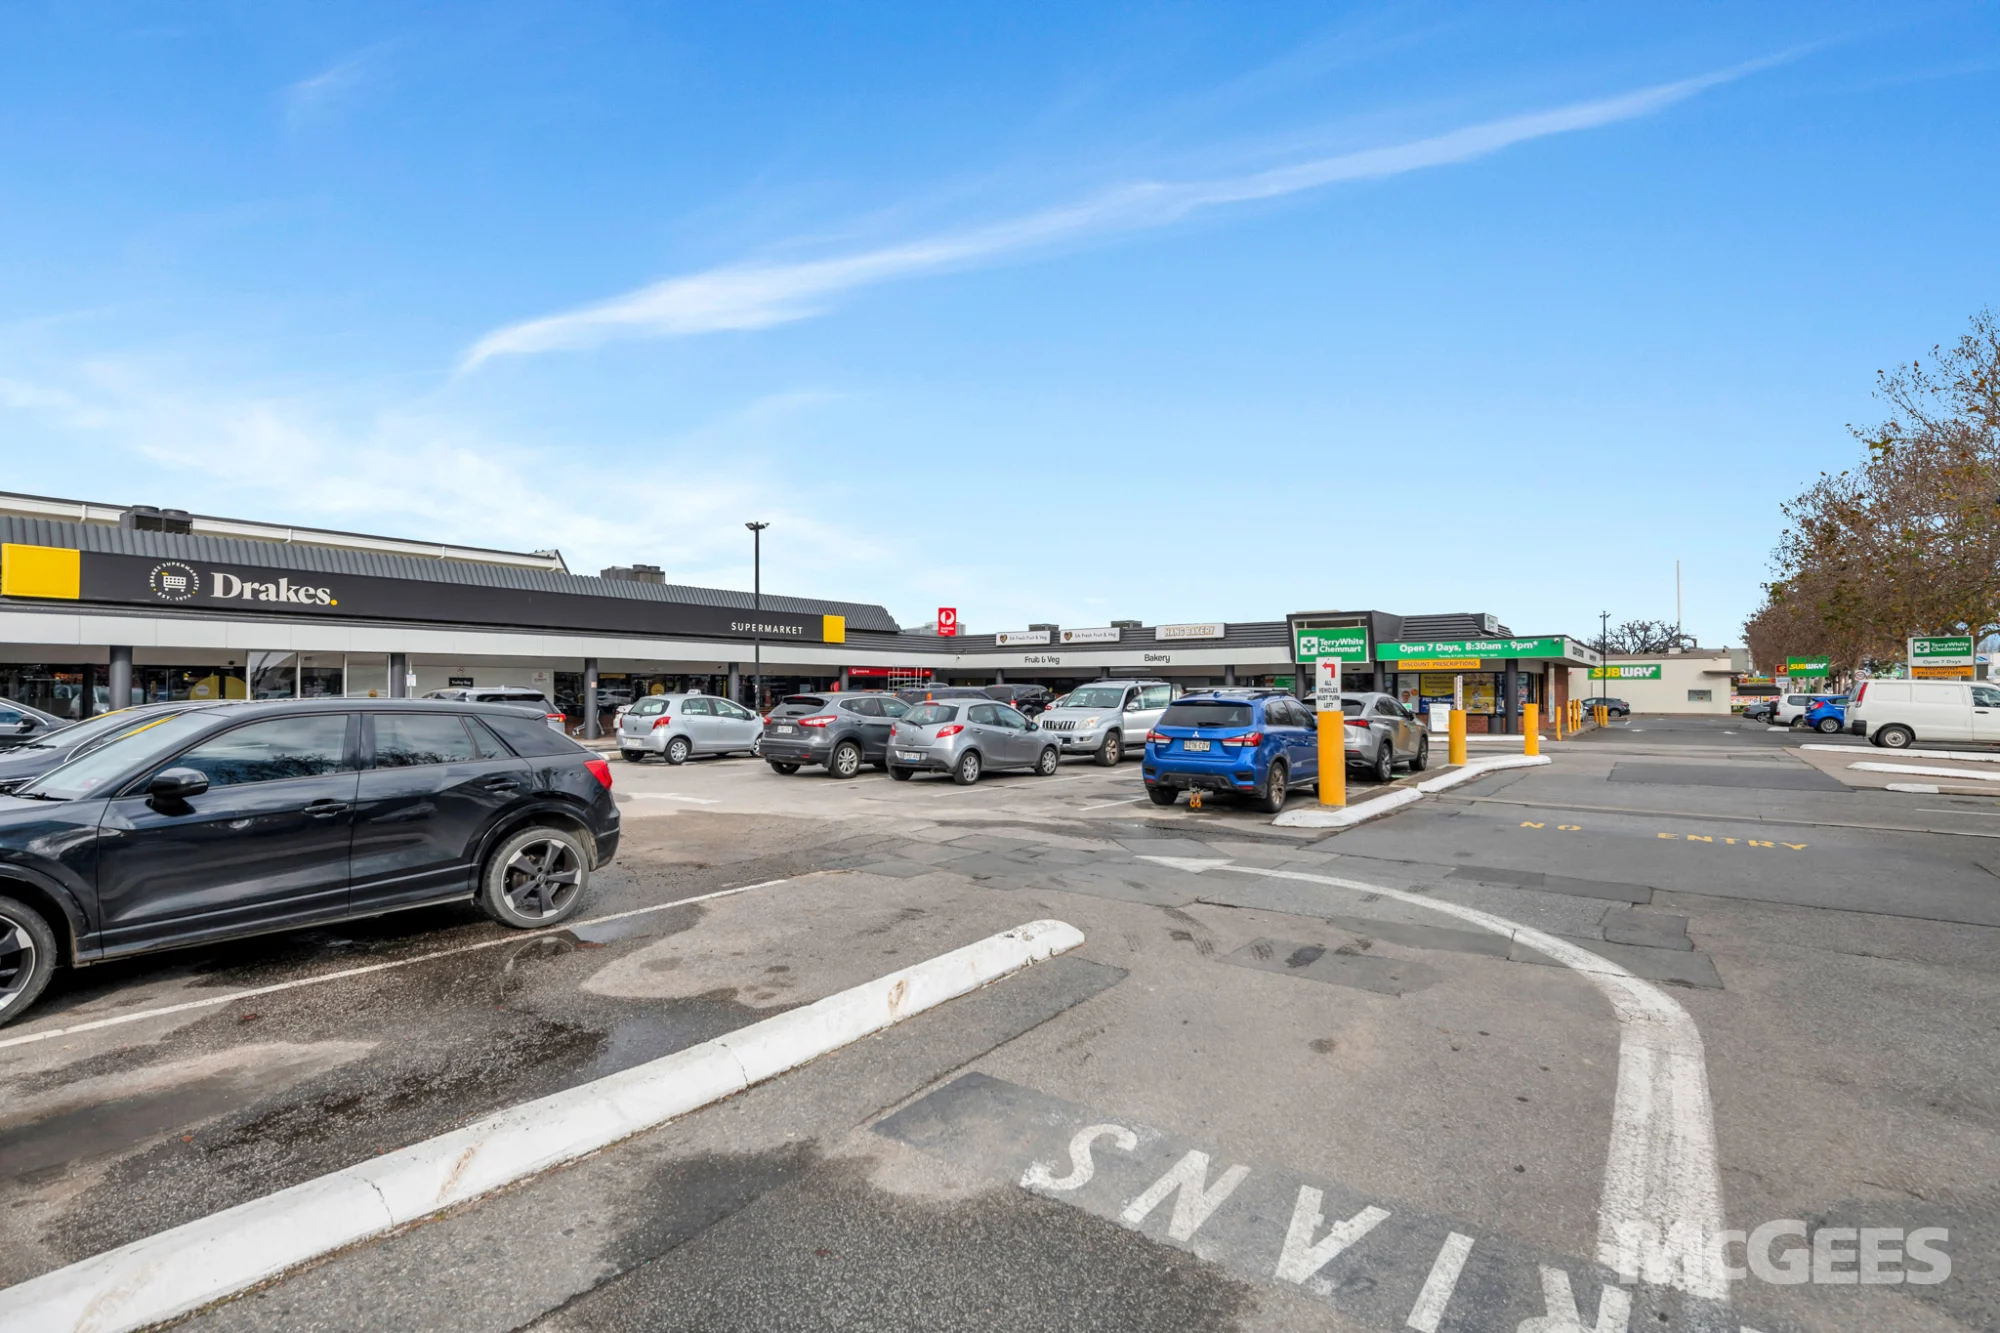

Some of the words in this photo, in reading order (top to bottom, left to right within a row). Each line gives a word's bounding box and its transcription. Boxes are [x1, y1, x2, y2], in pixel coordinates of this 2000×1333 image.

[731, 622, 803, 634] SUPERMARKET
[1164, 628, 1185, 637] HANG
[1186, 626, 1215, 636] BAKERY
[1319, 638, 1364, 646] TerryWhite
[1400, 644, 1424, 654] Open
[1427, 643, 1434, 652] 7
[1436, 642, 1461, 654] Days,
[1465, 642, 1501, 650] 8:30am
[1047, 656, 1060, 665] Veg
[1144, 654, 1170, 664] Bakery
[1592, 666, 1656, 678] SUBWAY
[1520, 821, 1582, 831] NO
[1656, 832, 1809, 850] ENTRY
